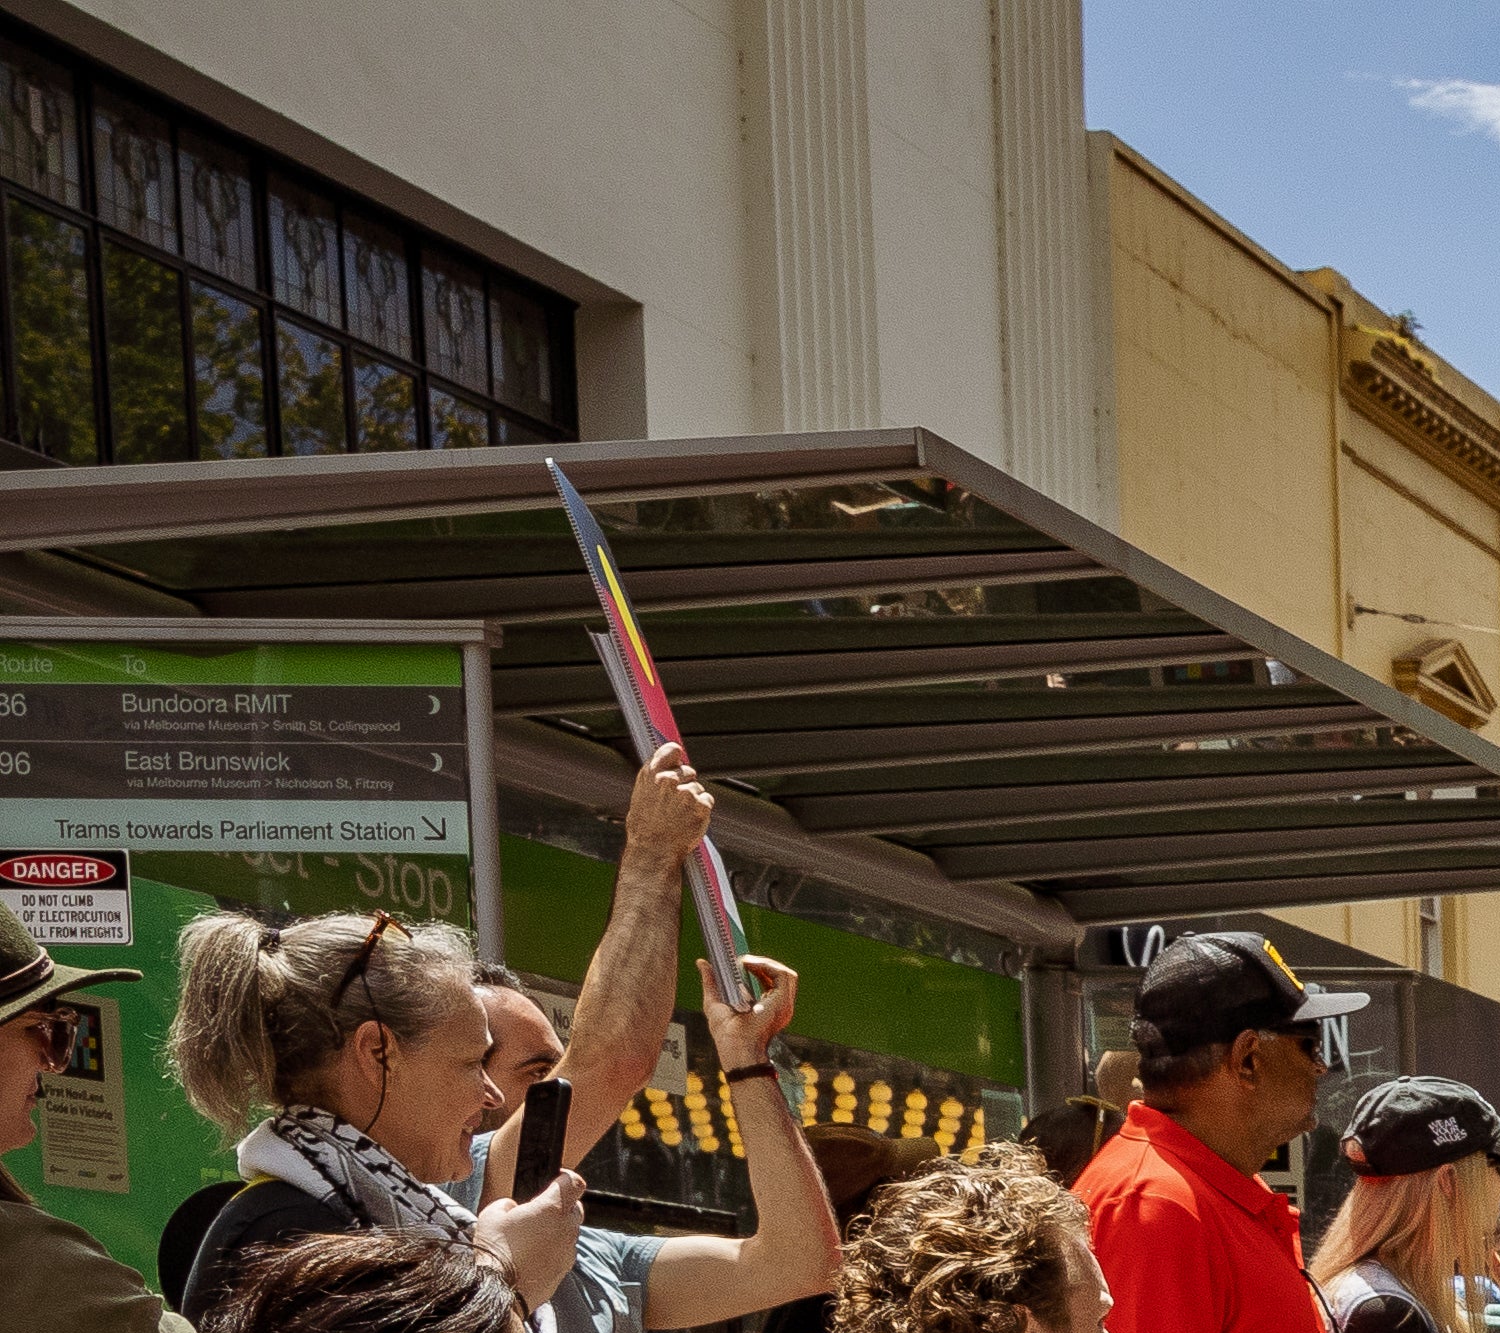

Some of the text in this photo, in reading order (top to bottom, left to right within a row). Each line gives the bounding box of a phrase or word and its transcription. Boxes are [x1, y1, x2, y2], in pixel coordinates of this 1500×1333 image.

[121, 655, 146, 674] To
[122, 693, 228, 713] Bundoora
[235, 694, 292, 713] RMIT
[124, 720, 140, 730] via
[144, 720, 204, 731] Melbourne
[208, 720, 258, 731] Museum
[273, 720, 306, 731] Smith
[329, 720, 400, 734] Collingwood
[125, 751, 172, 770] East
[179, 752, 290, 771] Brunswick
[128, 777, 144, 788] via
[147, 776, 208, 788] Melbourne
[212, 777, 260, 789] Museum
[276, 777, 333, 789] Nicholson
[356, 778, 394, 791] Fitzroy
[54, 819, 415, 840] Trams towards Parliament Station
[13, 862, 99, 879] DANGER
[22, 894, 94, 906] DO NOT CLIMB
[23, 910, 35, 921] OF
[39, 910, 121, 922] ELECTROCUTION
[50, 927, 77, 938] FROM
[81, 927, 123, 939] HEIGHTS
